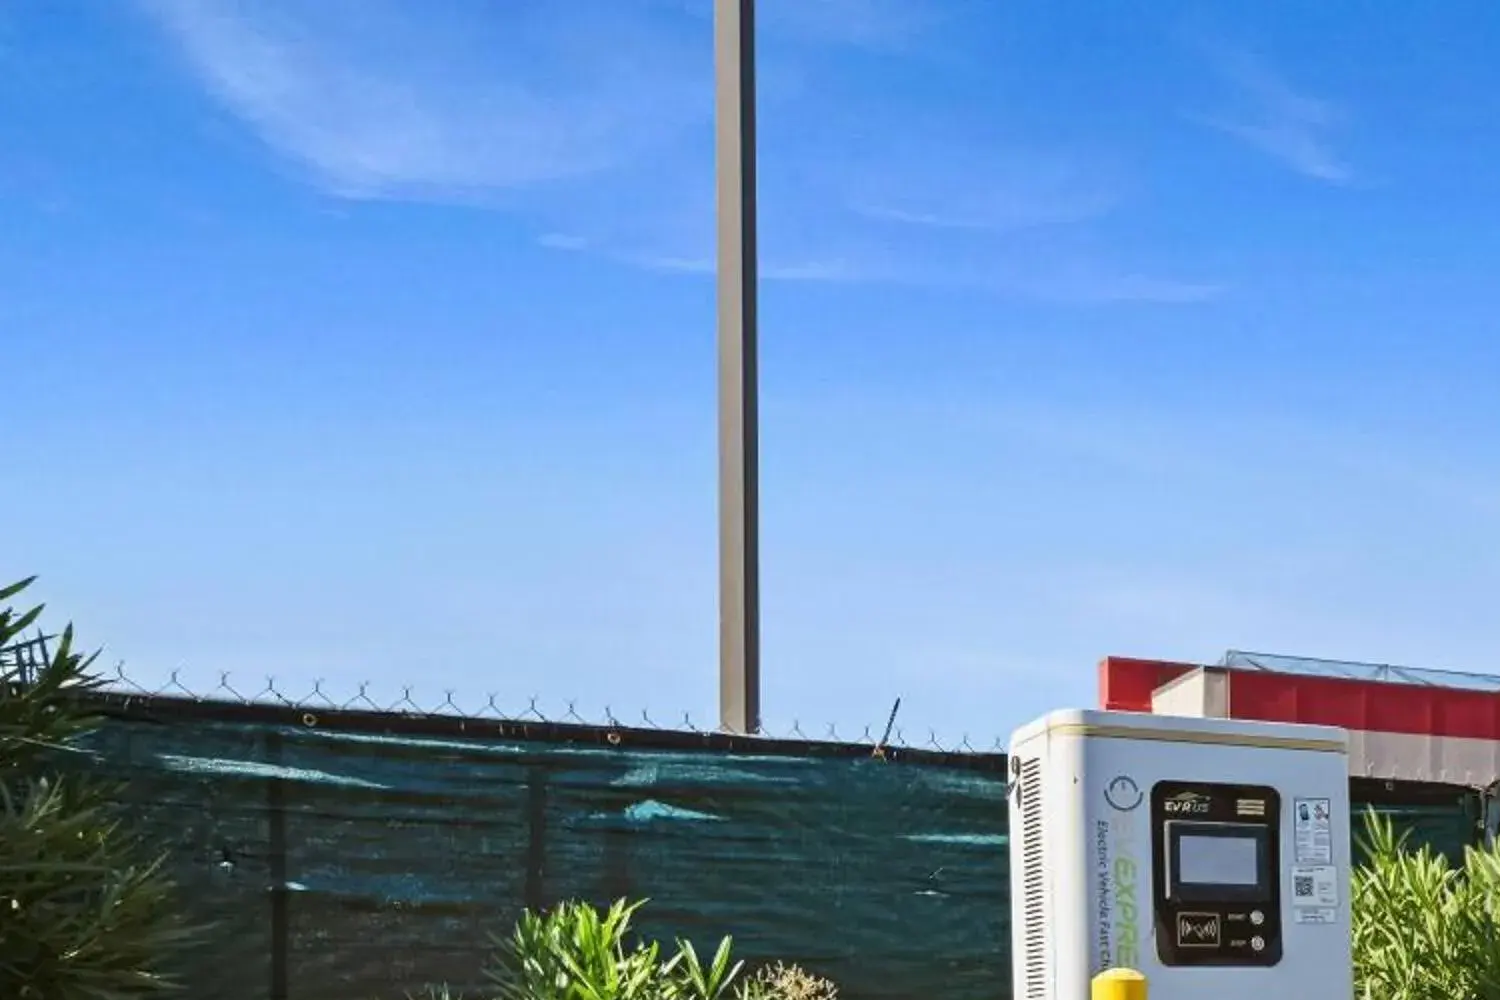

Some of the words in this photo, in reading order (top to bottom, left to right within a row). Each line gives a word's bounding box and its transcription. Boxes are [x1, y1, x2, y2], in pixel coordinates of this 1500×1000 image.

[1097, 820, 1109, 868] Electric
[1098, 872, 1111, 919] Vehicle
[1100, 921, 1111, 948] Fast
